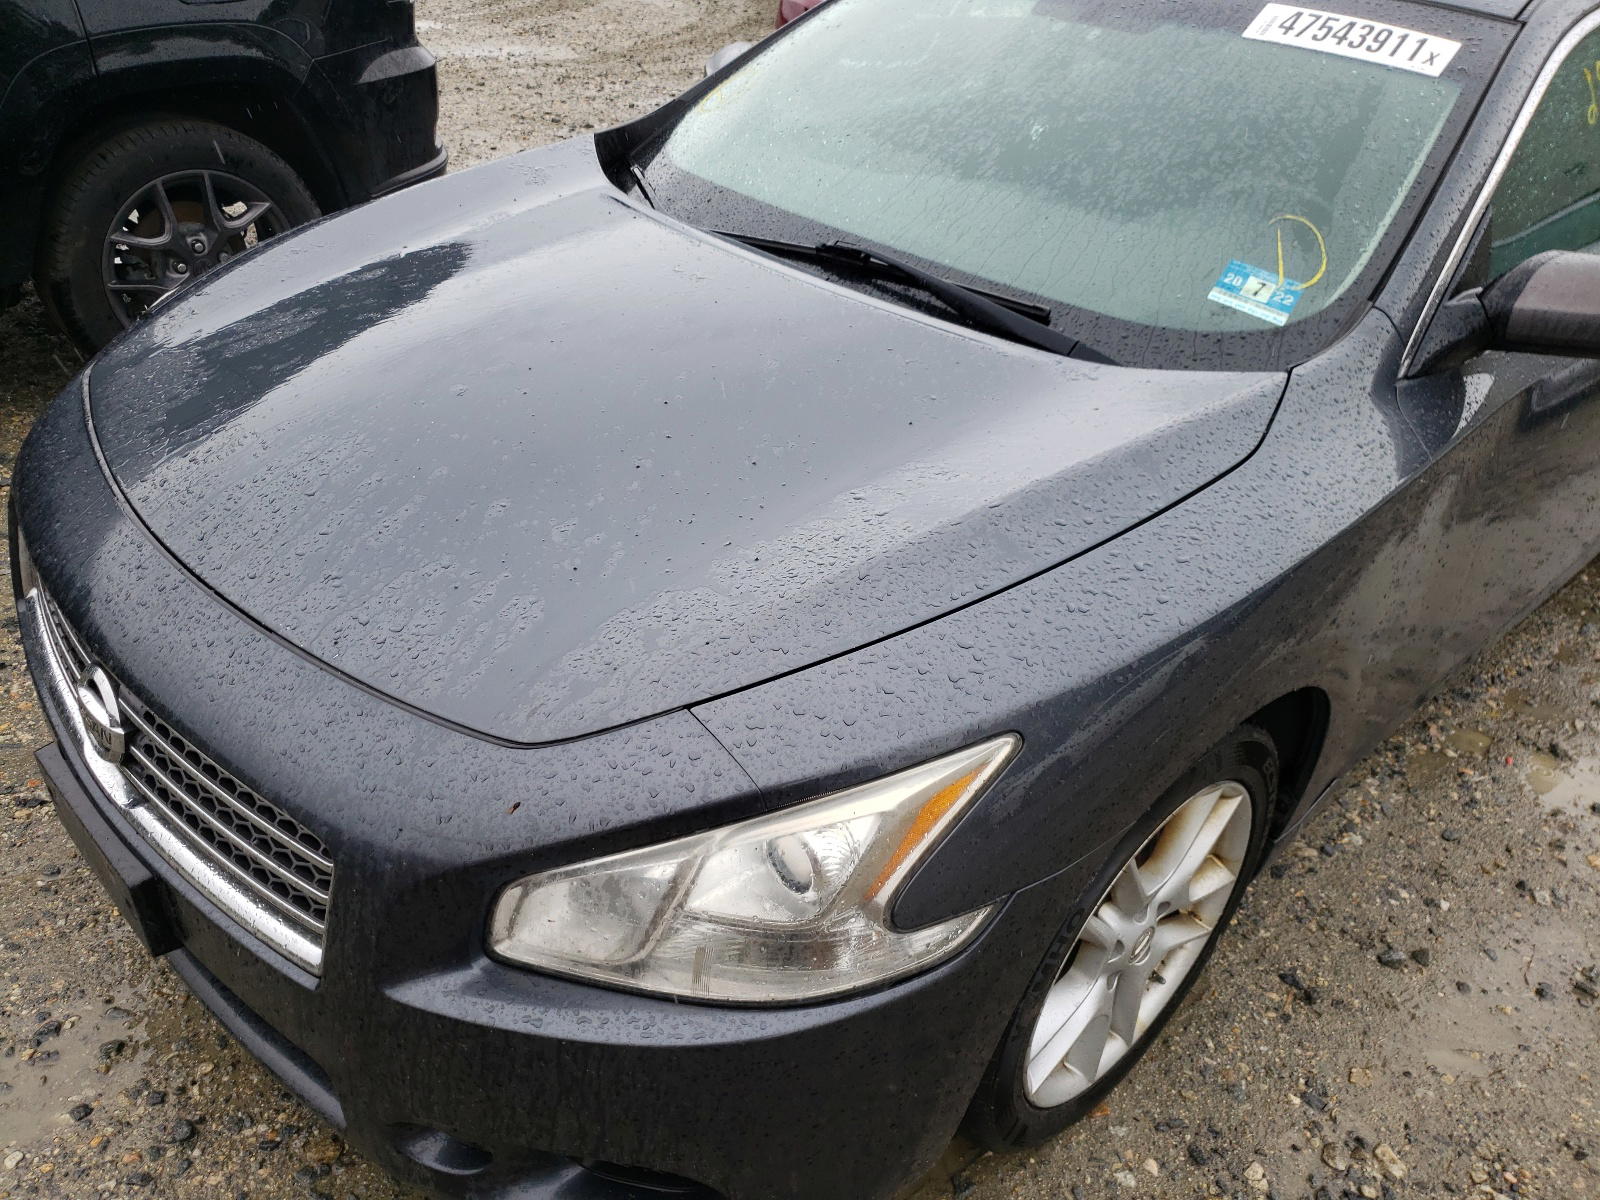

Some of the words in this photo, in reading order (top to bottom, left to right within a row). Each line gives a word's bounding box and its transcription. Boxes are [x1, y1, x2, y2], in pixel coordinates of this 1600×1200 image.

[1277, 10, 1429, 62] 47543911
[1223, 271, 1243, 287] 20
[1252, 281, 1267, 297] 7
[1272, 290, 1295, 306] 22
